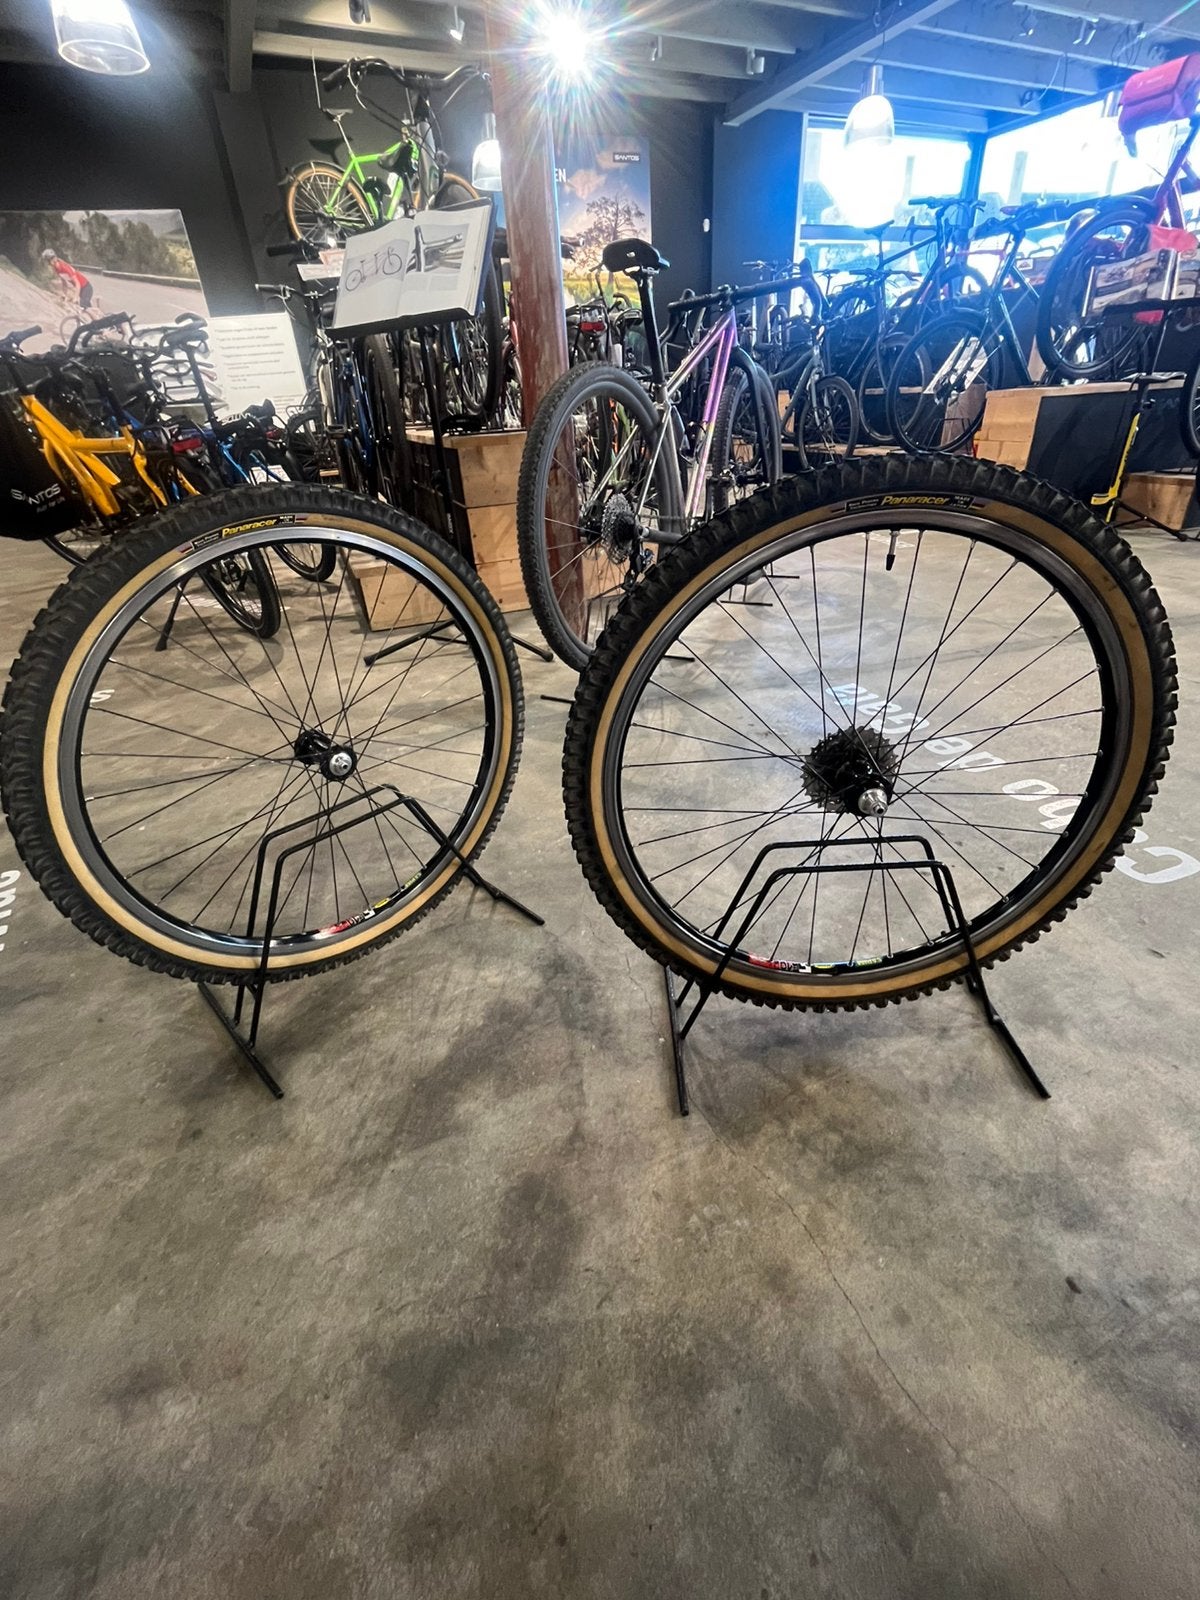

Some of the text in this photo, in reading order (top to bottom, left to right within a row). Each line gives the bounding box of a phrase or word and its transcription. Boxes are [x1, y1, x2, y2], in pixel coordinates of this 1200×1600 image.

[880, 495, 950, 506] Panaracer
[222, 519, 278, 539] Panaracer
[923, 736, 1007, 773] de
[1002, 779, 1200, 884] Cbo
